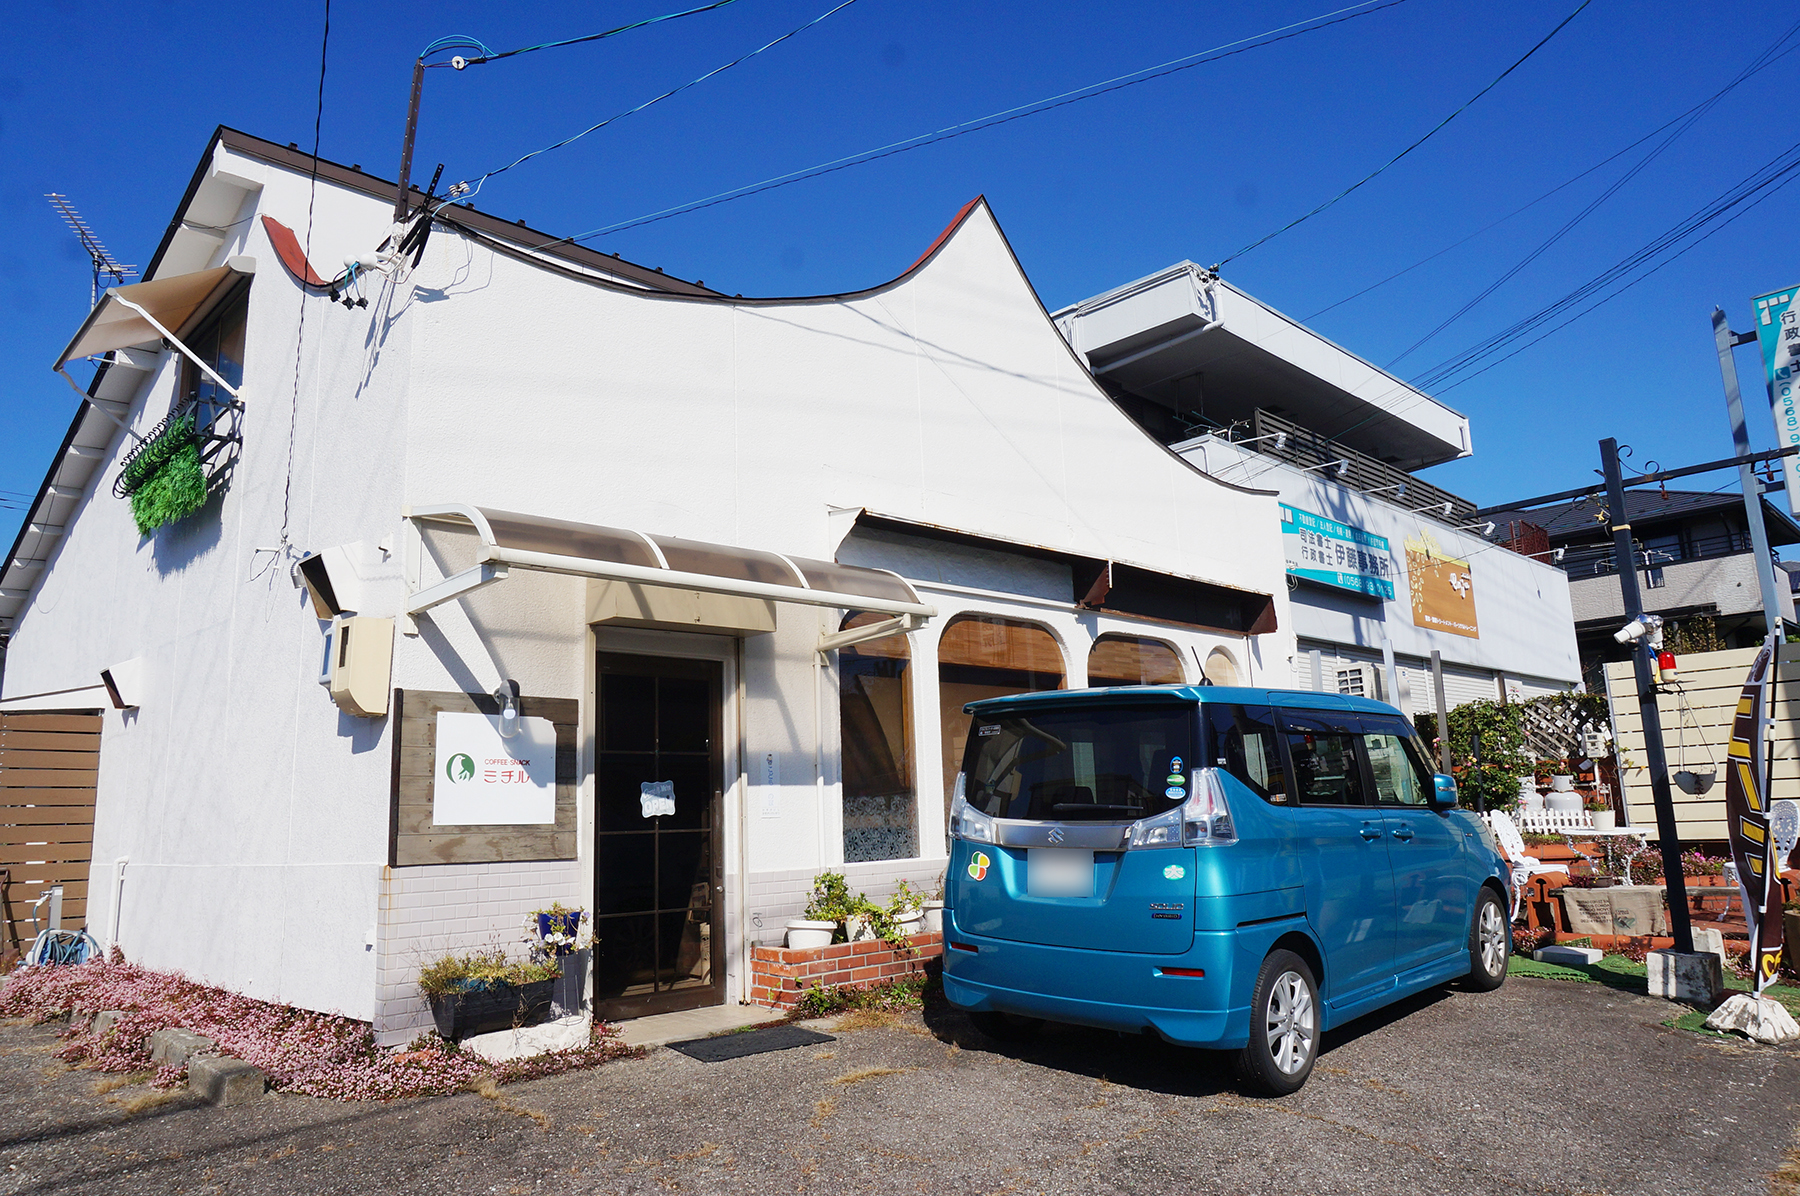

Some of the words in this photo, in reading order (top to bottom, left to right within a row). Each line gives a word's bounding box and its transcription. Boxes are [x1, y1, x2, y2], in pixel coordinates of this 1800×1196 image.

[1299, 527, 1332, 550] 司法書士
[1301, 545, 1333, 567] 行政書士
[1335, 543, 1389, 579] 伊藤事務所
[484, 758, 508, 766] COFFEE
[483, 770, 530, 784] ミチル
[644, 798, 673, 814] OPEN
